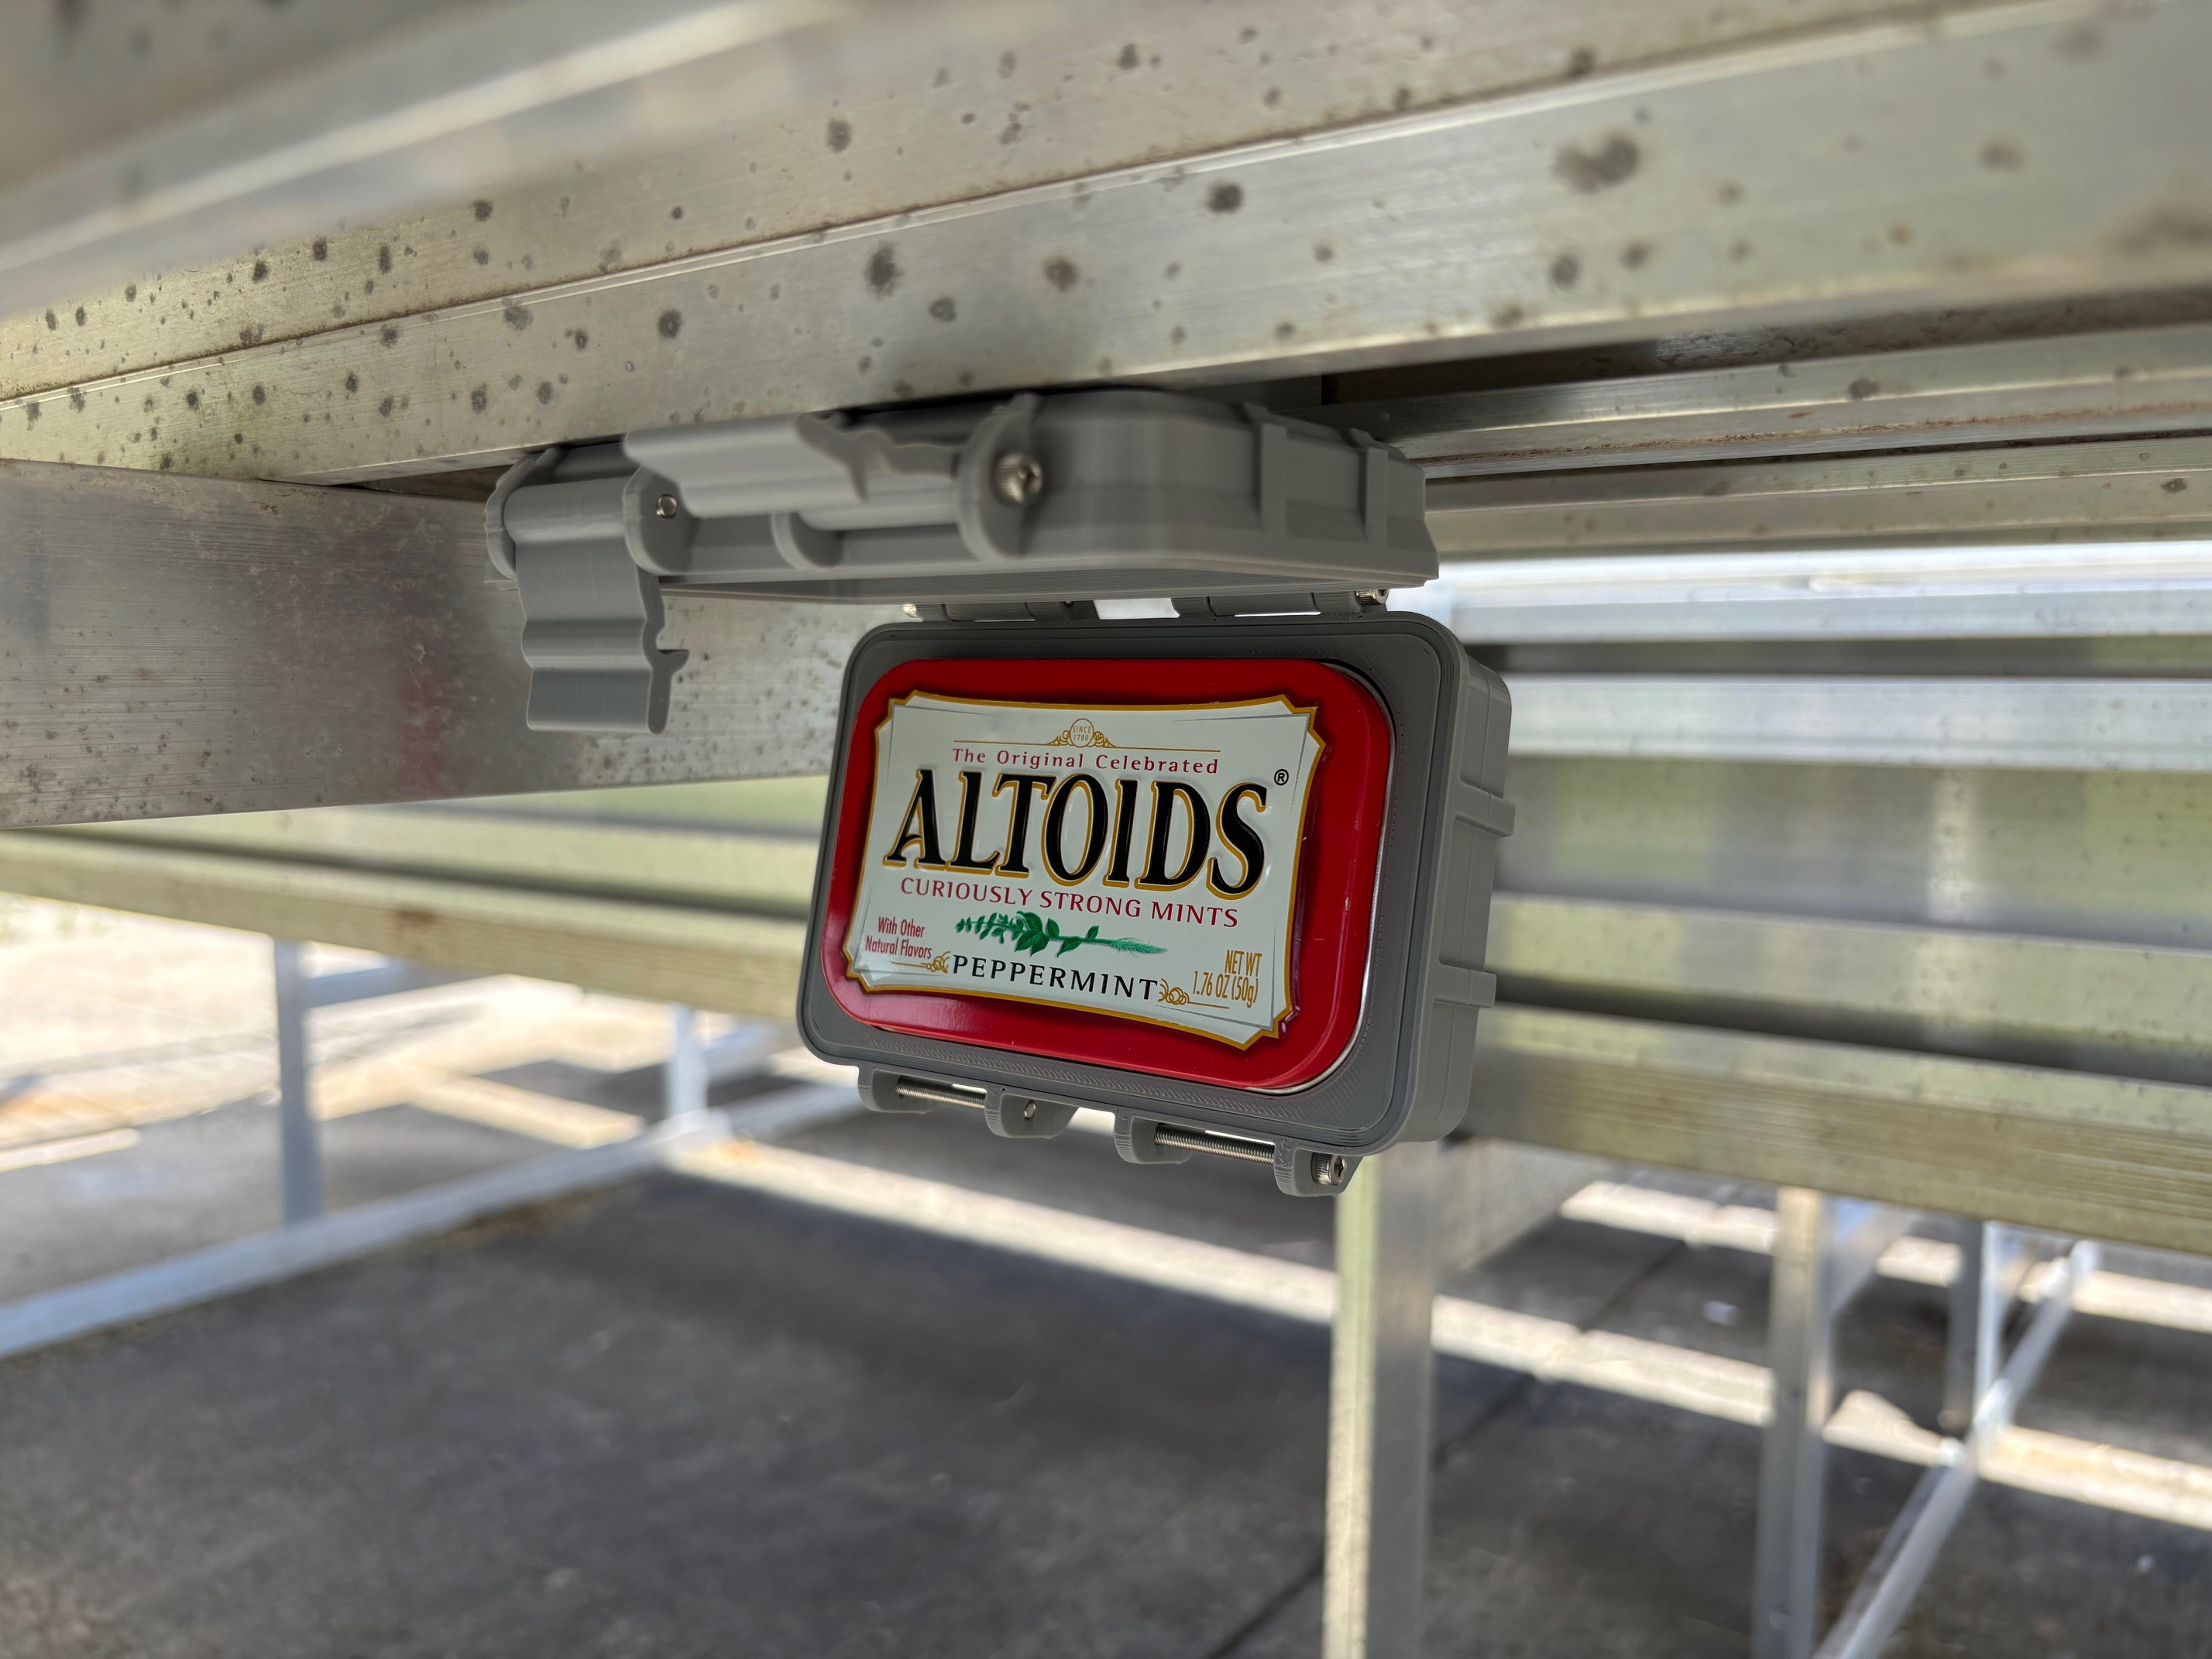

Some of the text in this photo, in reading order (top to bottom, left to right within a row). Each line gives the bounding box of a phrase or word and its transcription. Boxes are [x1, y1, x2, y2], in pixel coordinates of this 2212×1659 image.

[1072, 726, 1092, 734] SINCE
[953, 748, 1218, 774] The Original Celebrated
[901, 877, 1238, 928] CURIOUSLY STRONG MINTS
[878, 915, 926, 938] With Other
[865, 934, 933, 960] Natural Flavors
[1224, 949, 1262, 977] NET WT
[953, 954, 1158, 1001] PEPPERMINT
[1192, 970, 1259, 1008] 1.76 OZ (50g)
